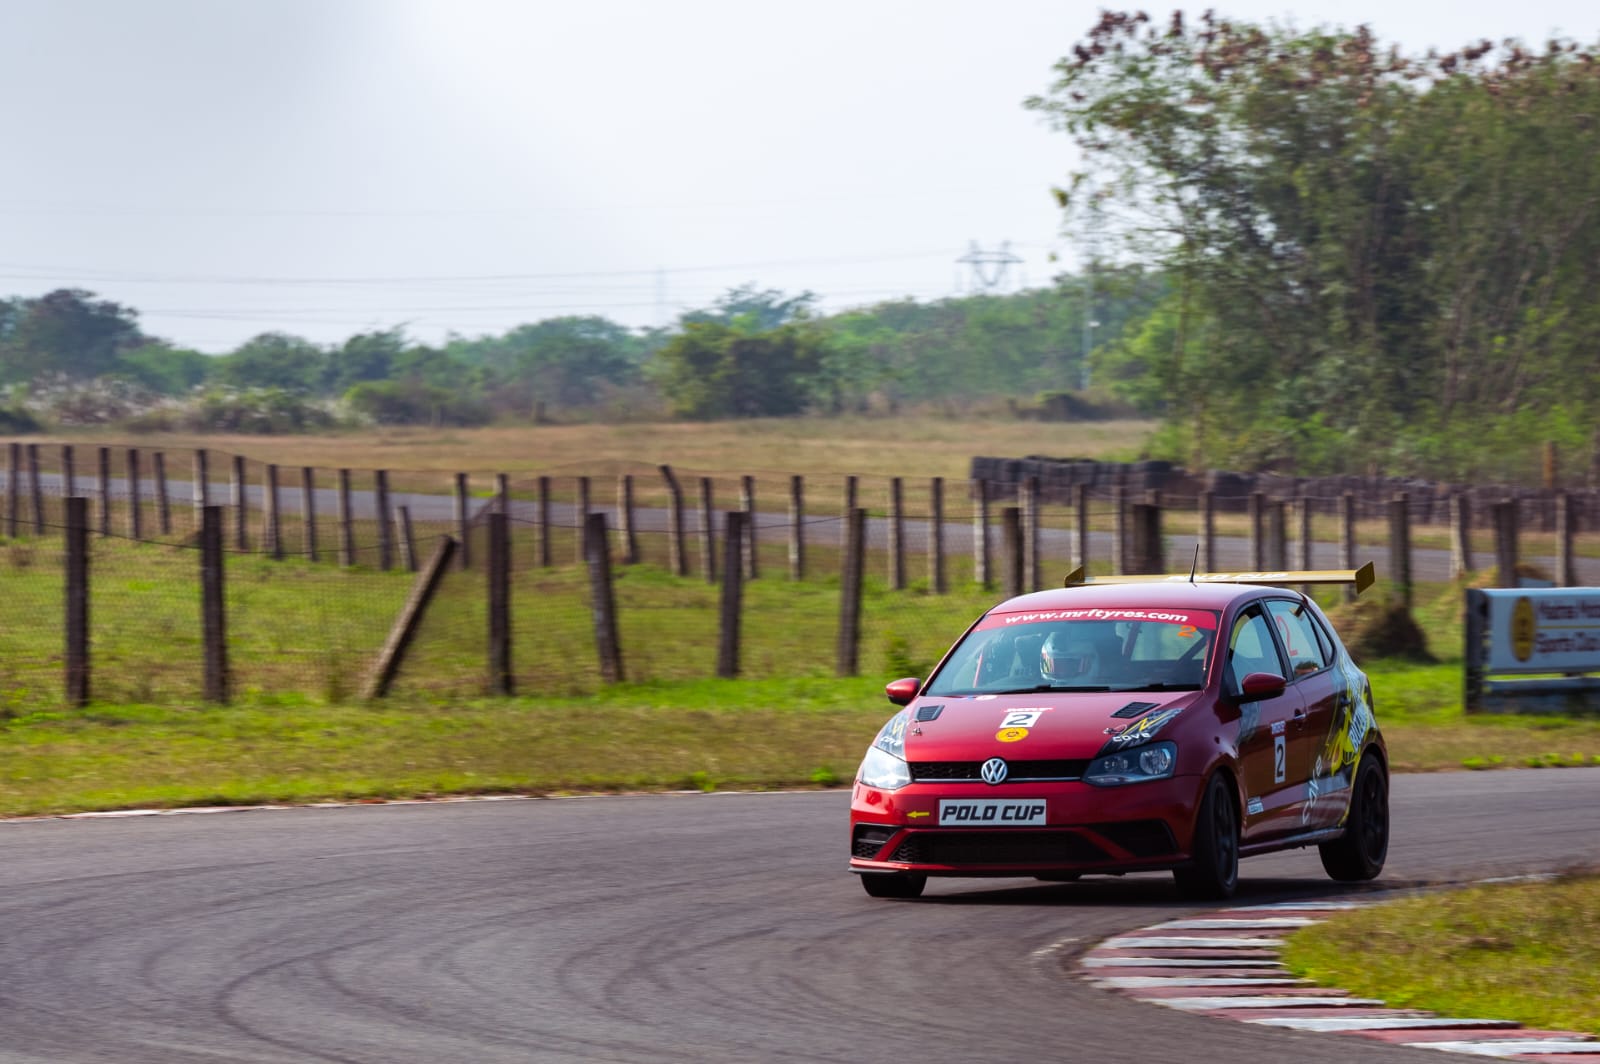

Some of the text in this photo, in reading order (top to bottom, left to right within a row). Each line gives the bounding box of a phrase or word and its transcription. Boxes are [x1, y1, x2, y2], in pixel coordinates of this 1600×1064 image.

[1005, 608, 1188, 624] www.mrftyres.com
[1177, 625, 1196, 638] 2
[1276, 615, 1298, 656] 2
[1006, 713, 1033, 726] 2
[1277, 744, 1284, 778] 2
[941, 805, 1045, 821] POLO CUP
